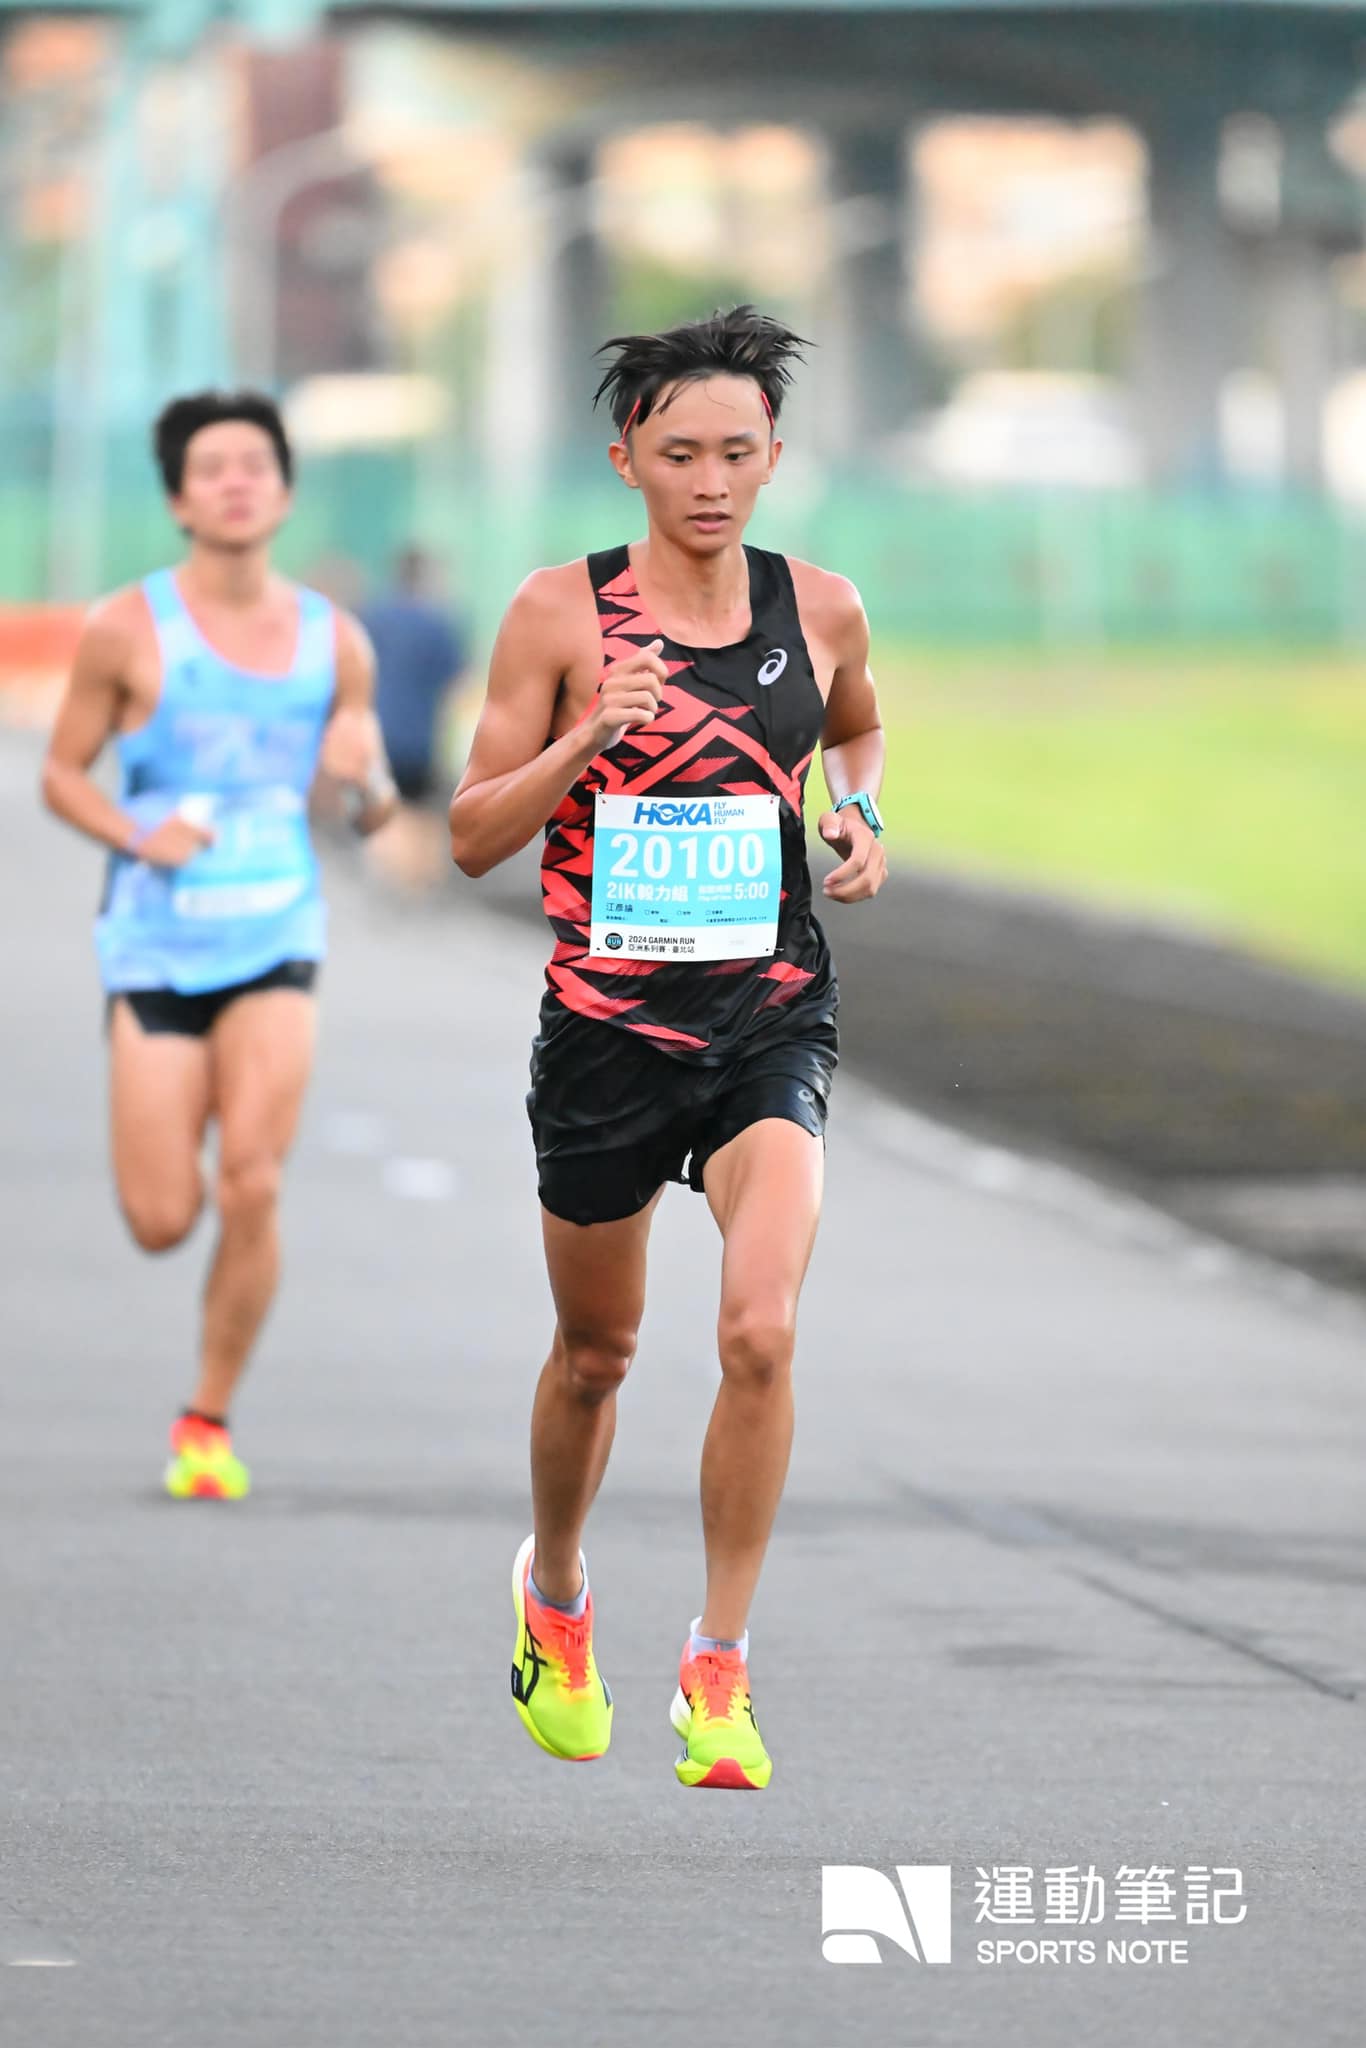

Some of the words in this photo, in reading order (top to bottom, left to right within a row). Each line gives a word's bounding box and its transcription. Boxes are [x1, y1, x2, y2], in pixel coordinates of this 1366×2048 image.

[633, 802, 712, 826] HOKA
[714, 809, 744, 817] HUMAN
[714, 817, 727, 825] FLY
[609, 832, 765, 880] 20100
[735, 881, 769, 900] 5:00
[628, 935, 647, 943] 2024
[648, 936, 678, 945] GARMIN
[679, 937, 696, 945] RUN
